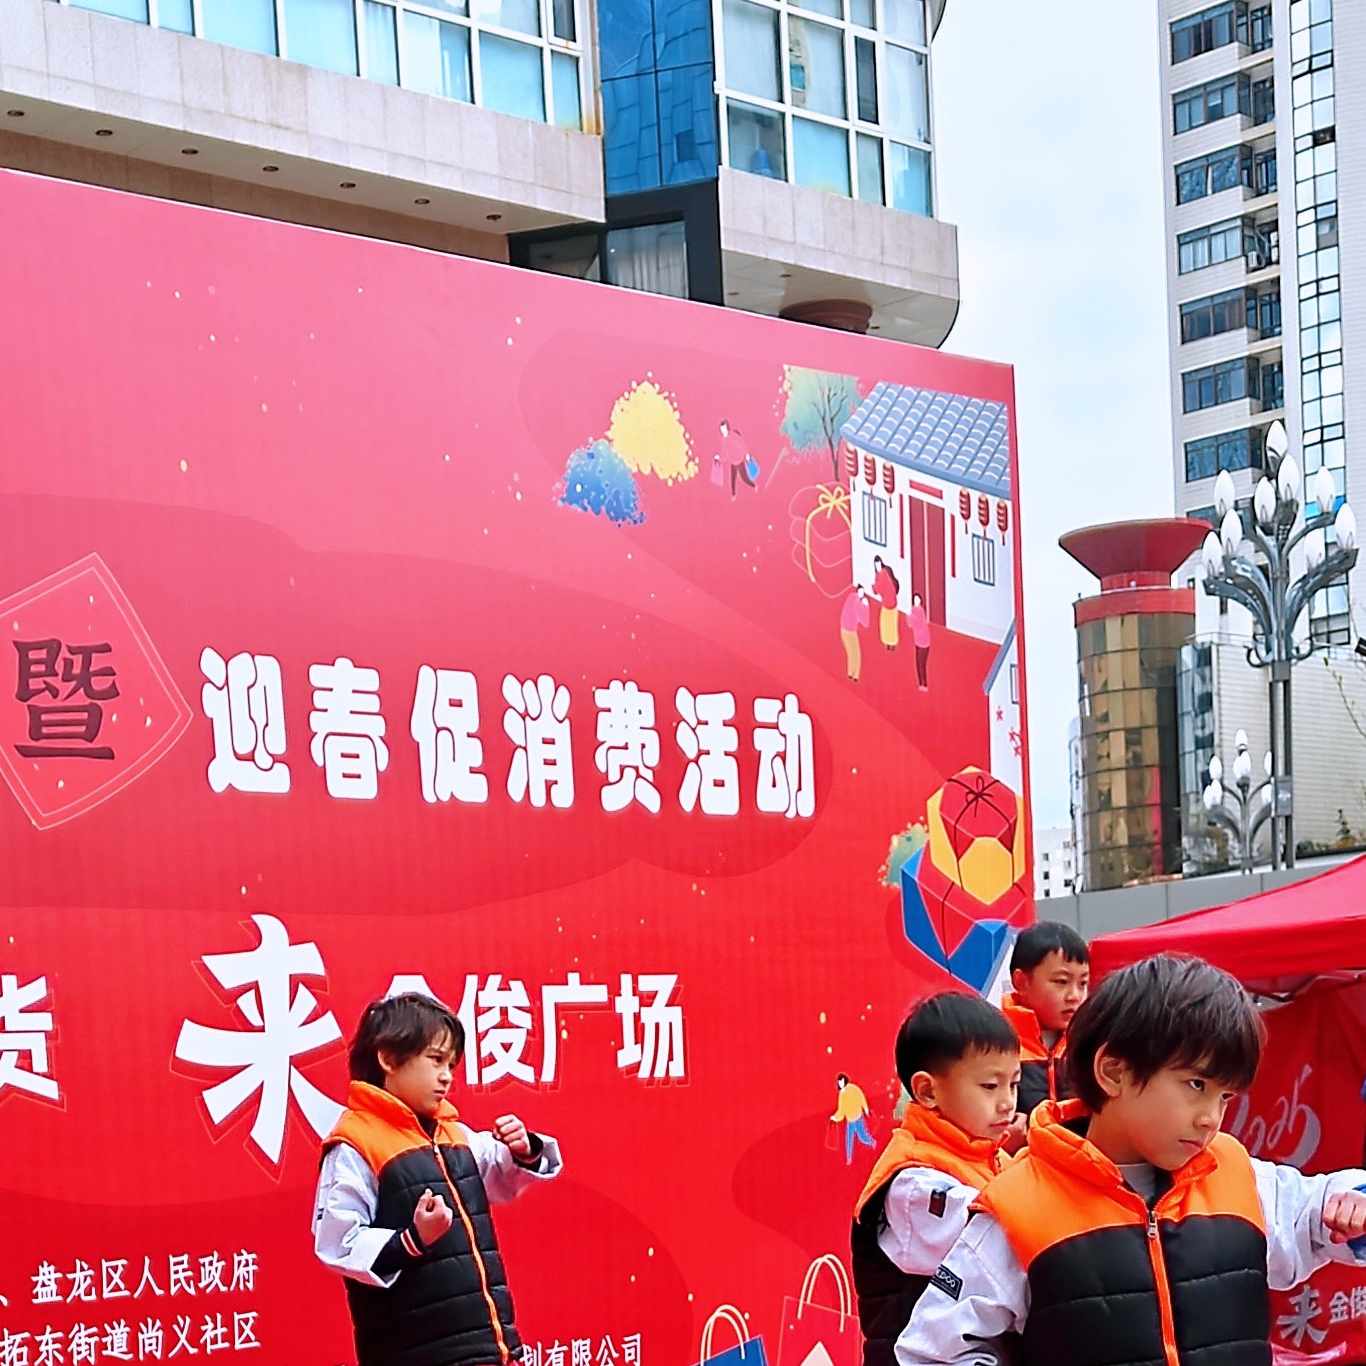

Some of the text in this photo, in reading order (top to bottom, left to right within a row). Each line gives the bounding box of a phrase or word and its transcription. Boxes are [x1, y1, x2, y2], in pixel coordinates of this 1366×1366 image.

[11, 637, 121, 763] 暨
[198, 645, 816, 818] 迎春促消费活动
[175, 914, 344, 1165] 来
[1276, 1283, 1329, 1348] 来
